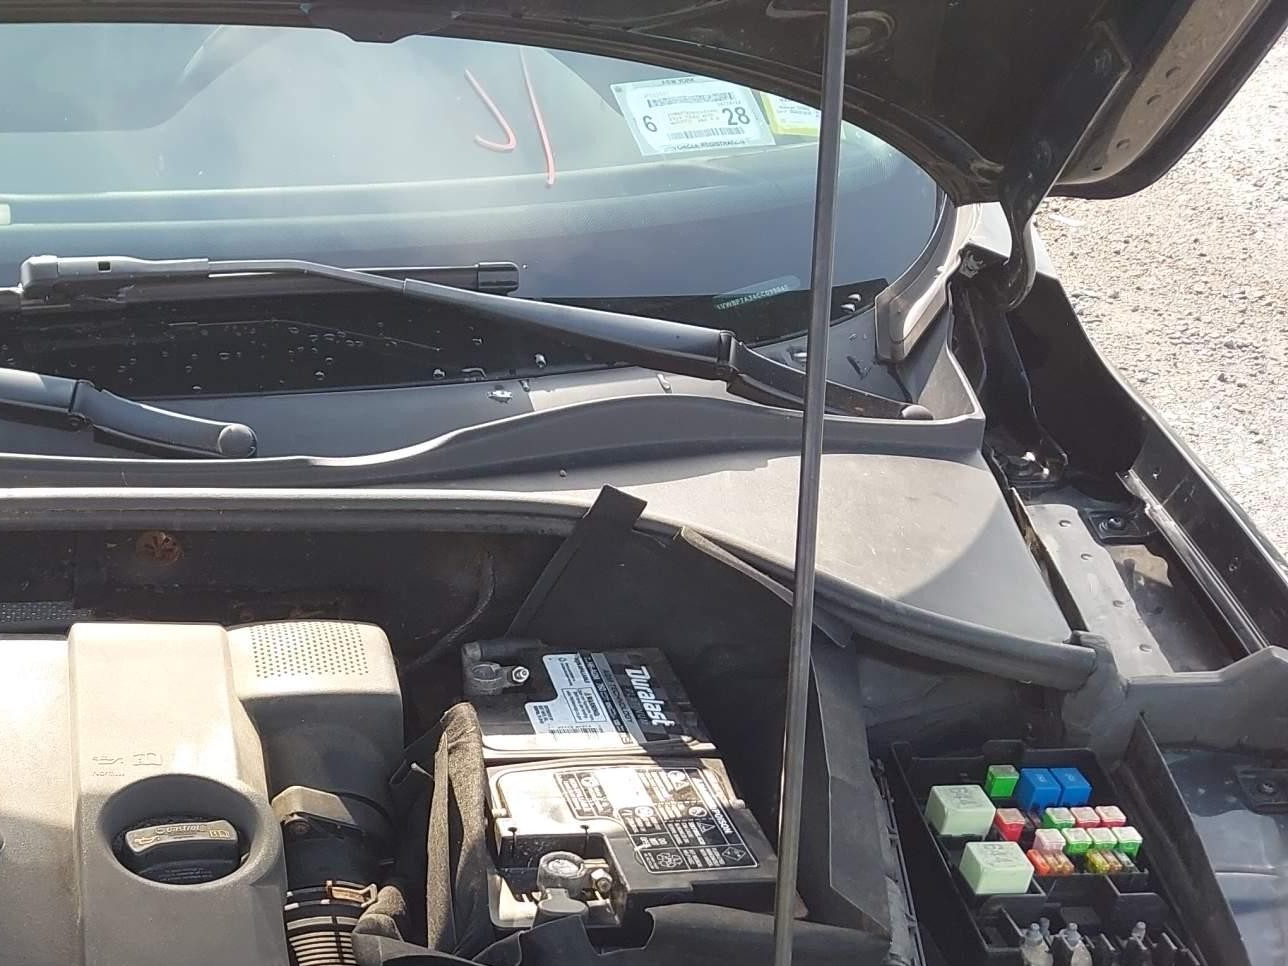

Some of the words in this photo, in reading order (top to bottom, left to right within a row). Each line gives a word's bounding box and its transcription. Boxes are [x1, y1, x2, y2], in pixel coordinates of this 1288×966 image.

[642, 115, 658, 133] 6
[721, 106, 751, 126] 28
[624, 665, 676, 727] Duralast
[166, 825, 201, 833] Castrol
[711, 809, 733, 835] POISON
